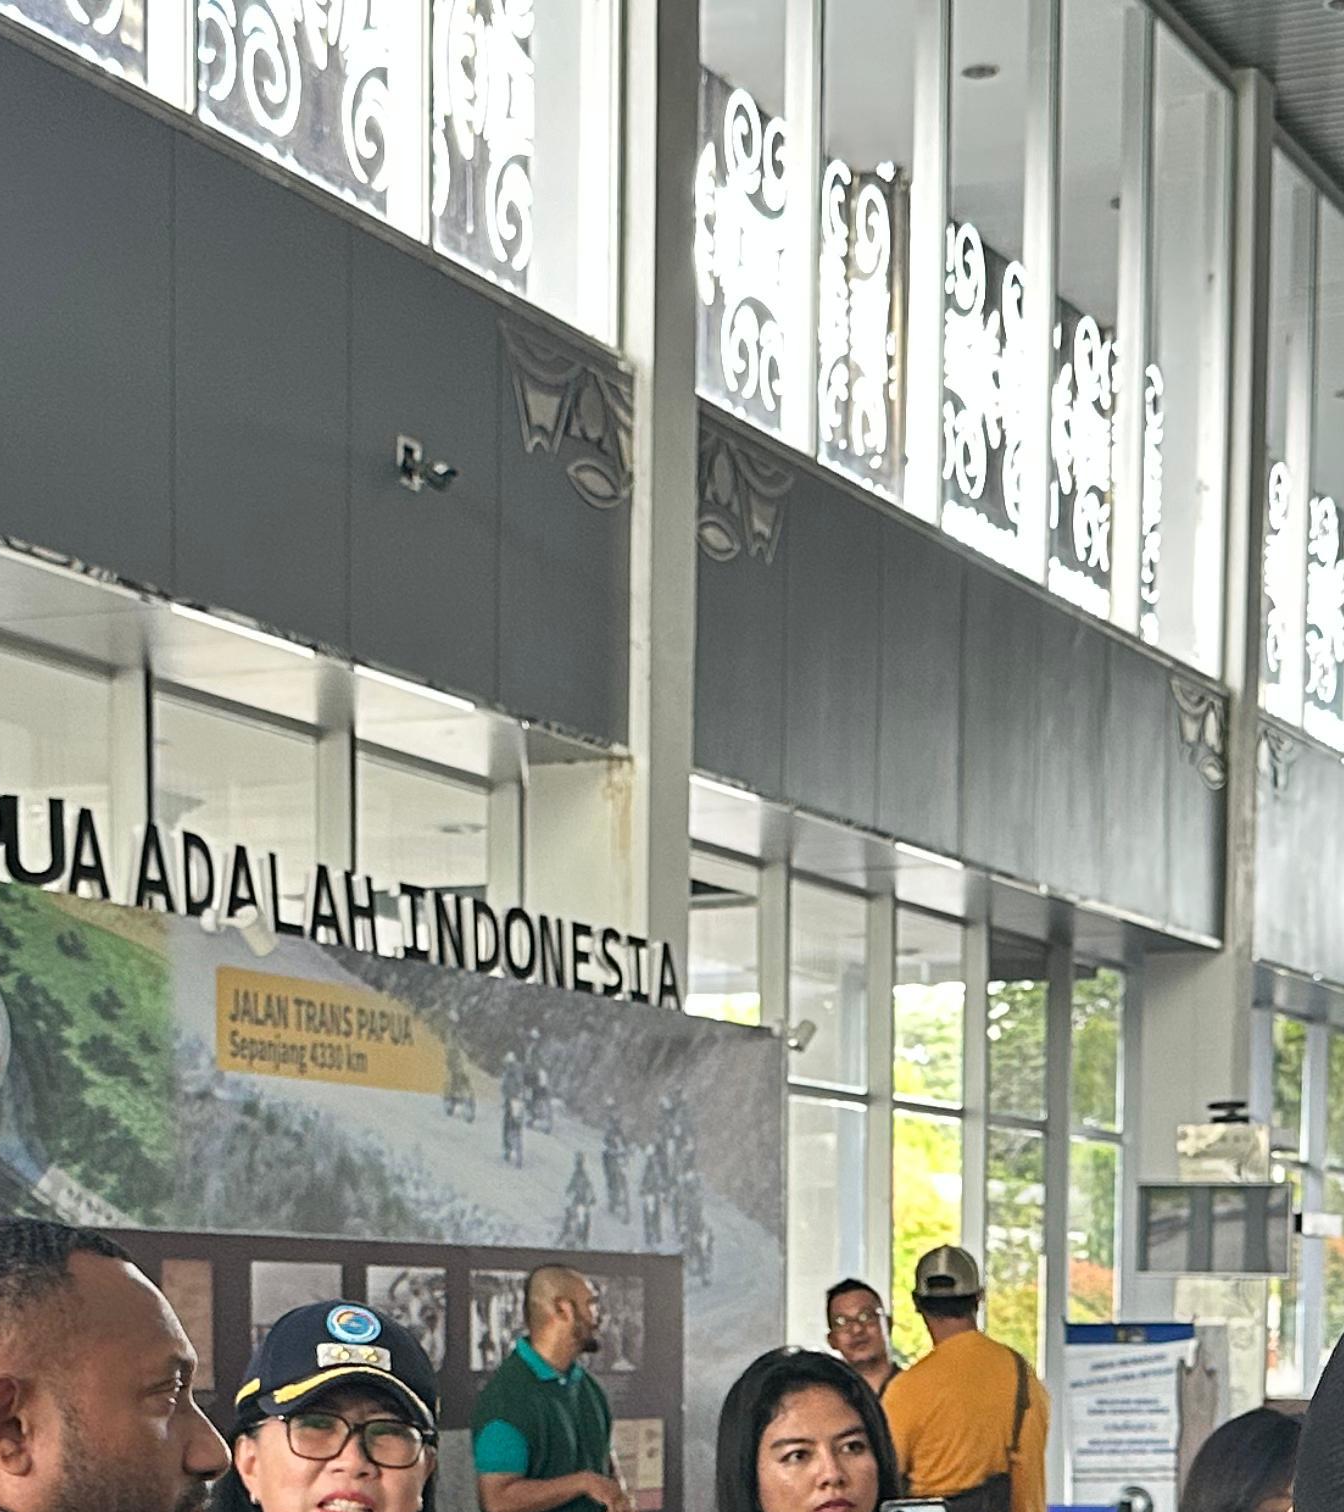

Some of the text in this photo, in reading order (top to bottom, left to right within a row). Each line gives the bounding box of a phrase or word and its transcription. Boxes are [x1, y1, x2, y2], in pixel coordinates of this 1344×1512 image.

[136, 822, 378, 955] ADALAH
[399, 882, 683, 1012] INDONESIA
[228, 988, 415, 1046] JALAN TRANS PAPUA
[229, 1029, 307, 1075] Sepanjang
[346, 1043, 369, 1073] km
